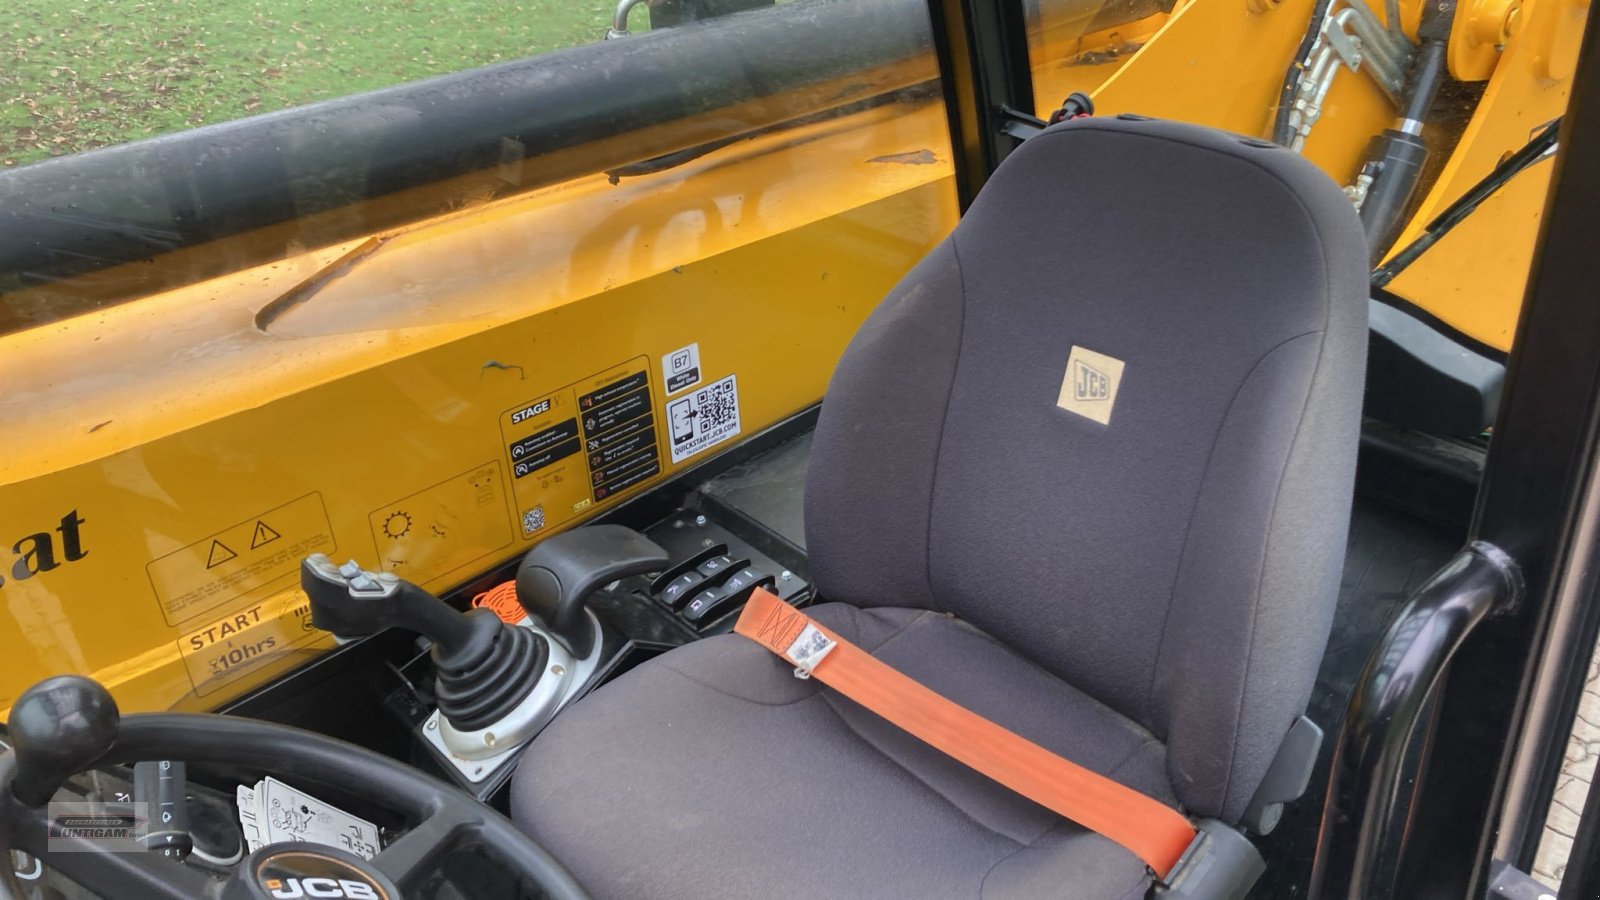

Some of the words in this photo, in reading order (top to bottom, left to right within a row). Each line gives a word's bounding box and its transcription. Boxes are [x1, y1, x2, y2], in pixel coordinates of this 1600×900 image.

[674, 354, 688, 369] B7
[670, 379, 686, 391] Diesel
[686, 375, 697, 384] Only
[676, 372, 691, 382] White
[1078, 365, 1107, 398] JCB
[512, 400, 549, 424] STAGE
[674, 421, 737, 456] QUICKSTART.JCB.COM
[190, 606, 262, 651] START
[219, 636, 276, 669] 10hrs
[271, 877, 379, 900] JCB
